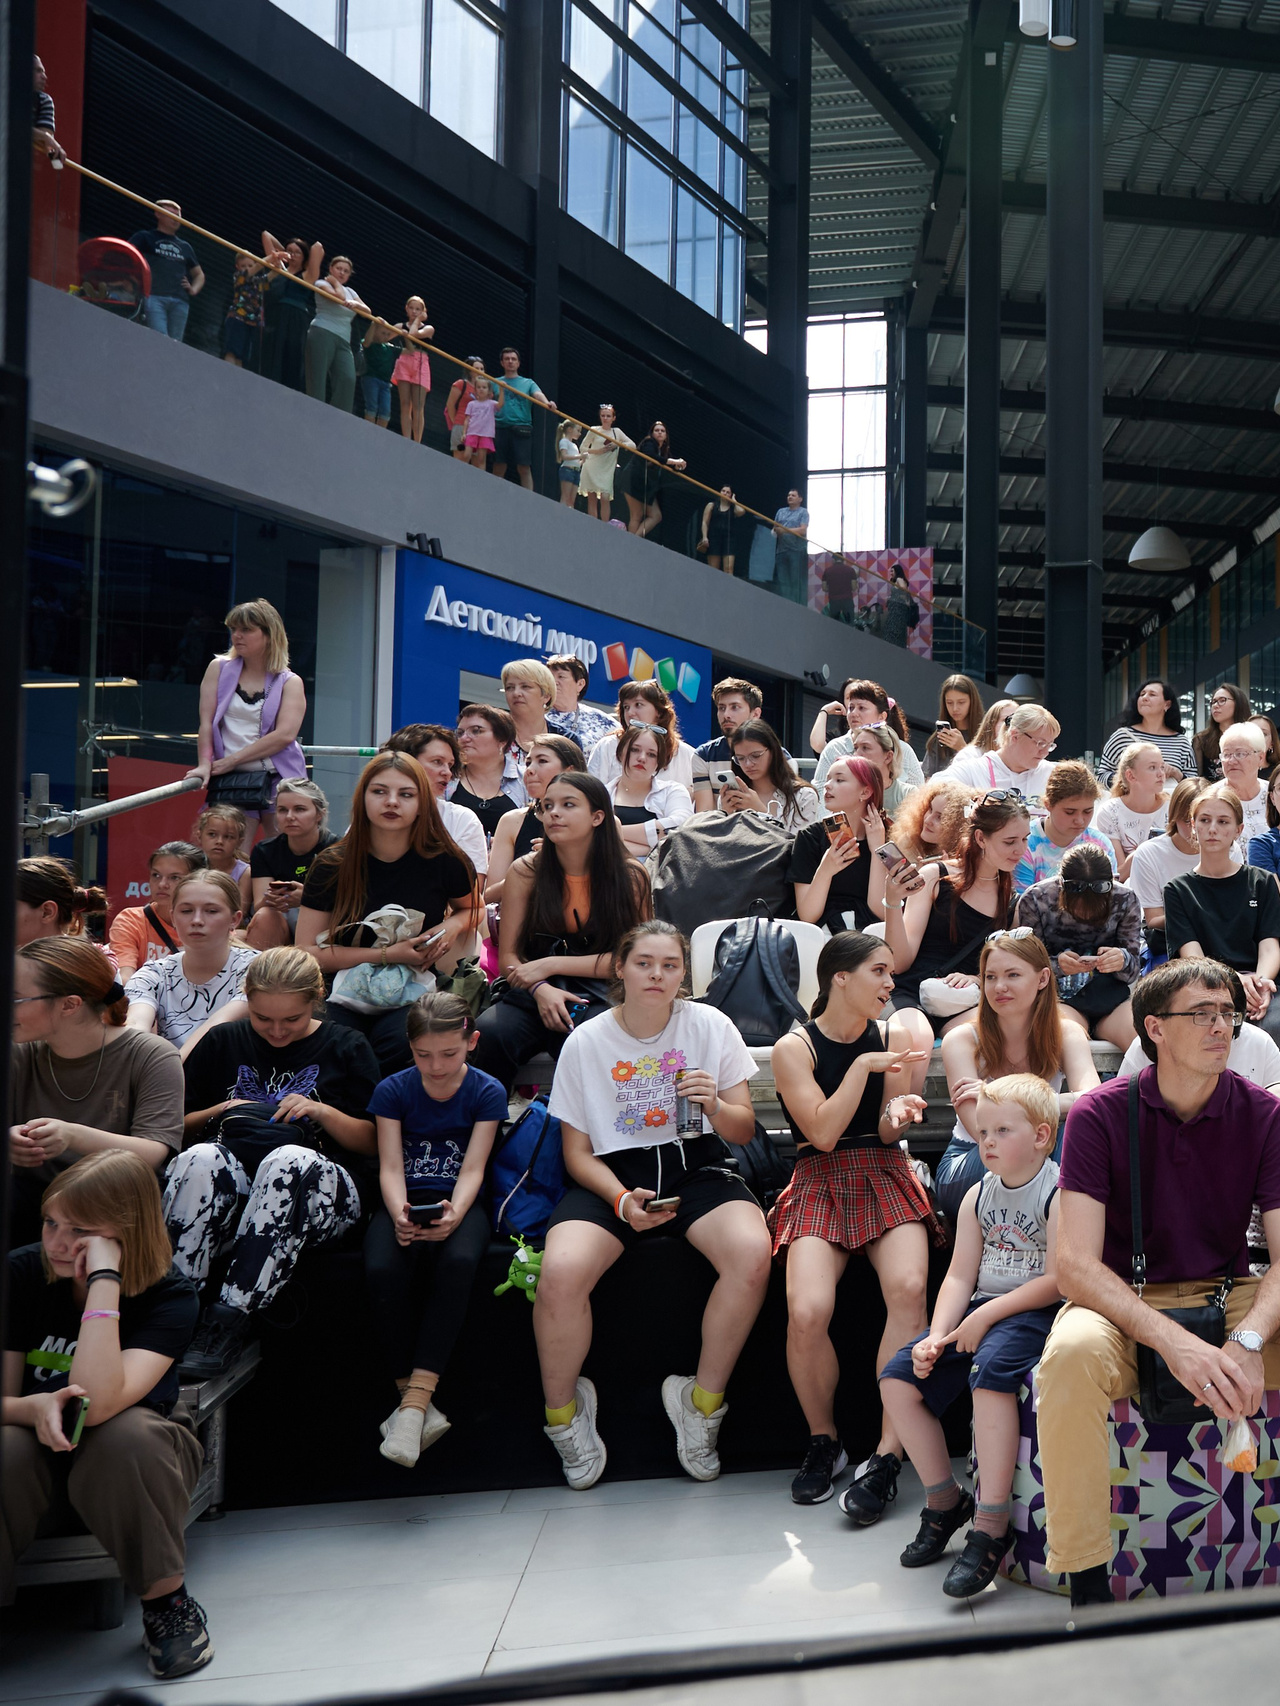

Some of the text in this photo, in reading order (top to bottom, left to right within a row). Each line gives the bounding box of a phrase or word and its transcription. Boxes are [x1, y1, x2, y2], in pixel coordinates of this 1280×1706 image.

[425, 585, 598, 672] Детский мир
[616, 1084, 676, 1102] JUST B
